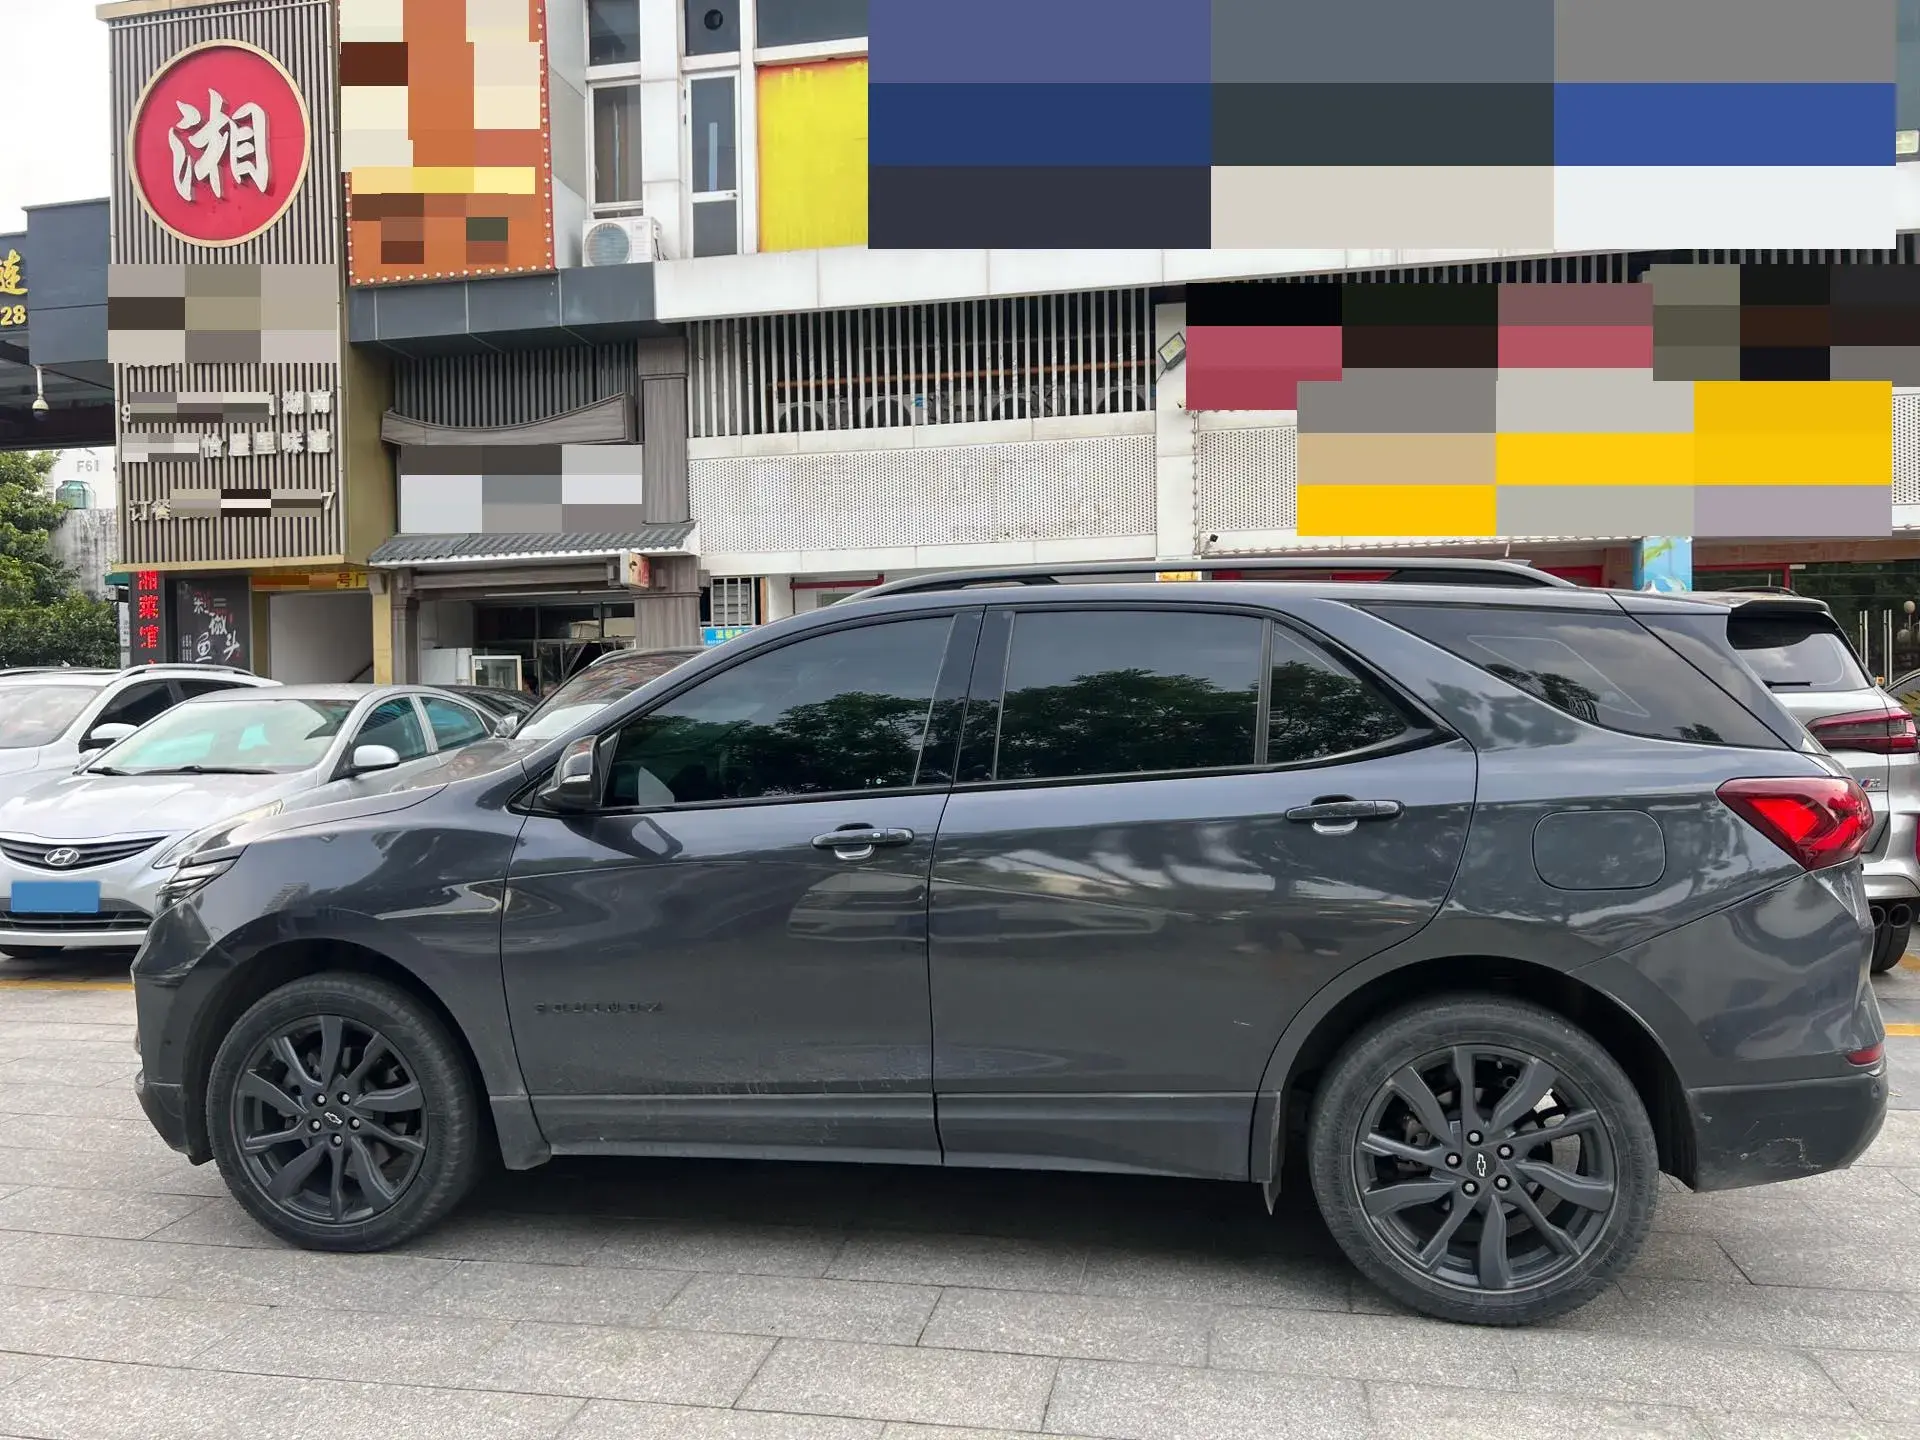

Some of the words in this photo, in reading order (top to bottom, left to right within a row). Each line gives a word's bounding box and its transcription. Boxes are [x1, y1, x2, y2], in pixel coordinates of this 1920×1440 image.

[168, 88, 269, 202] 湘
[138, 570, 159, 665] 湘菜馆
